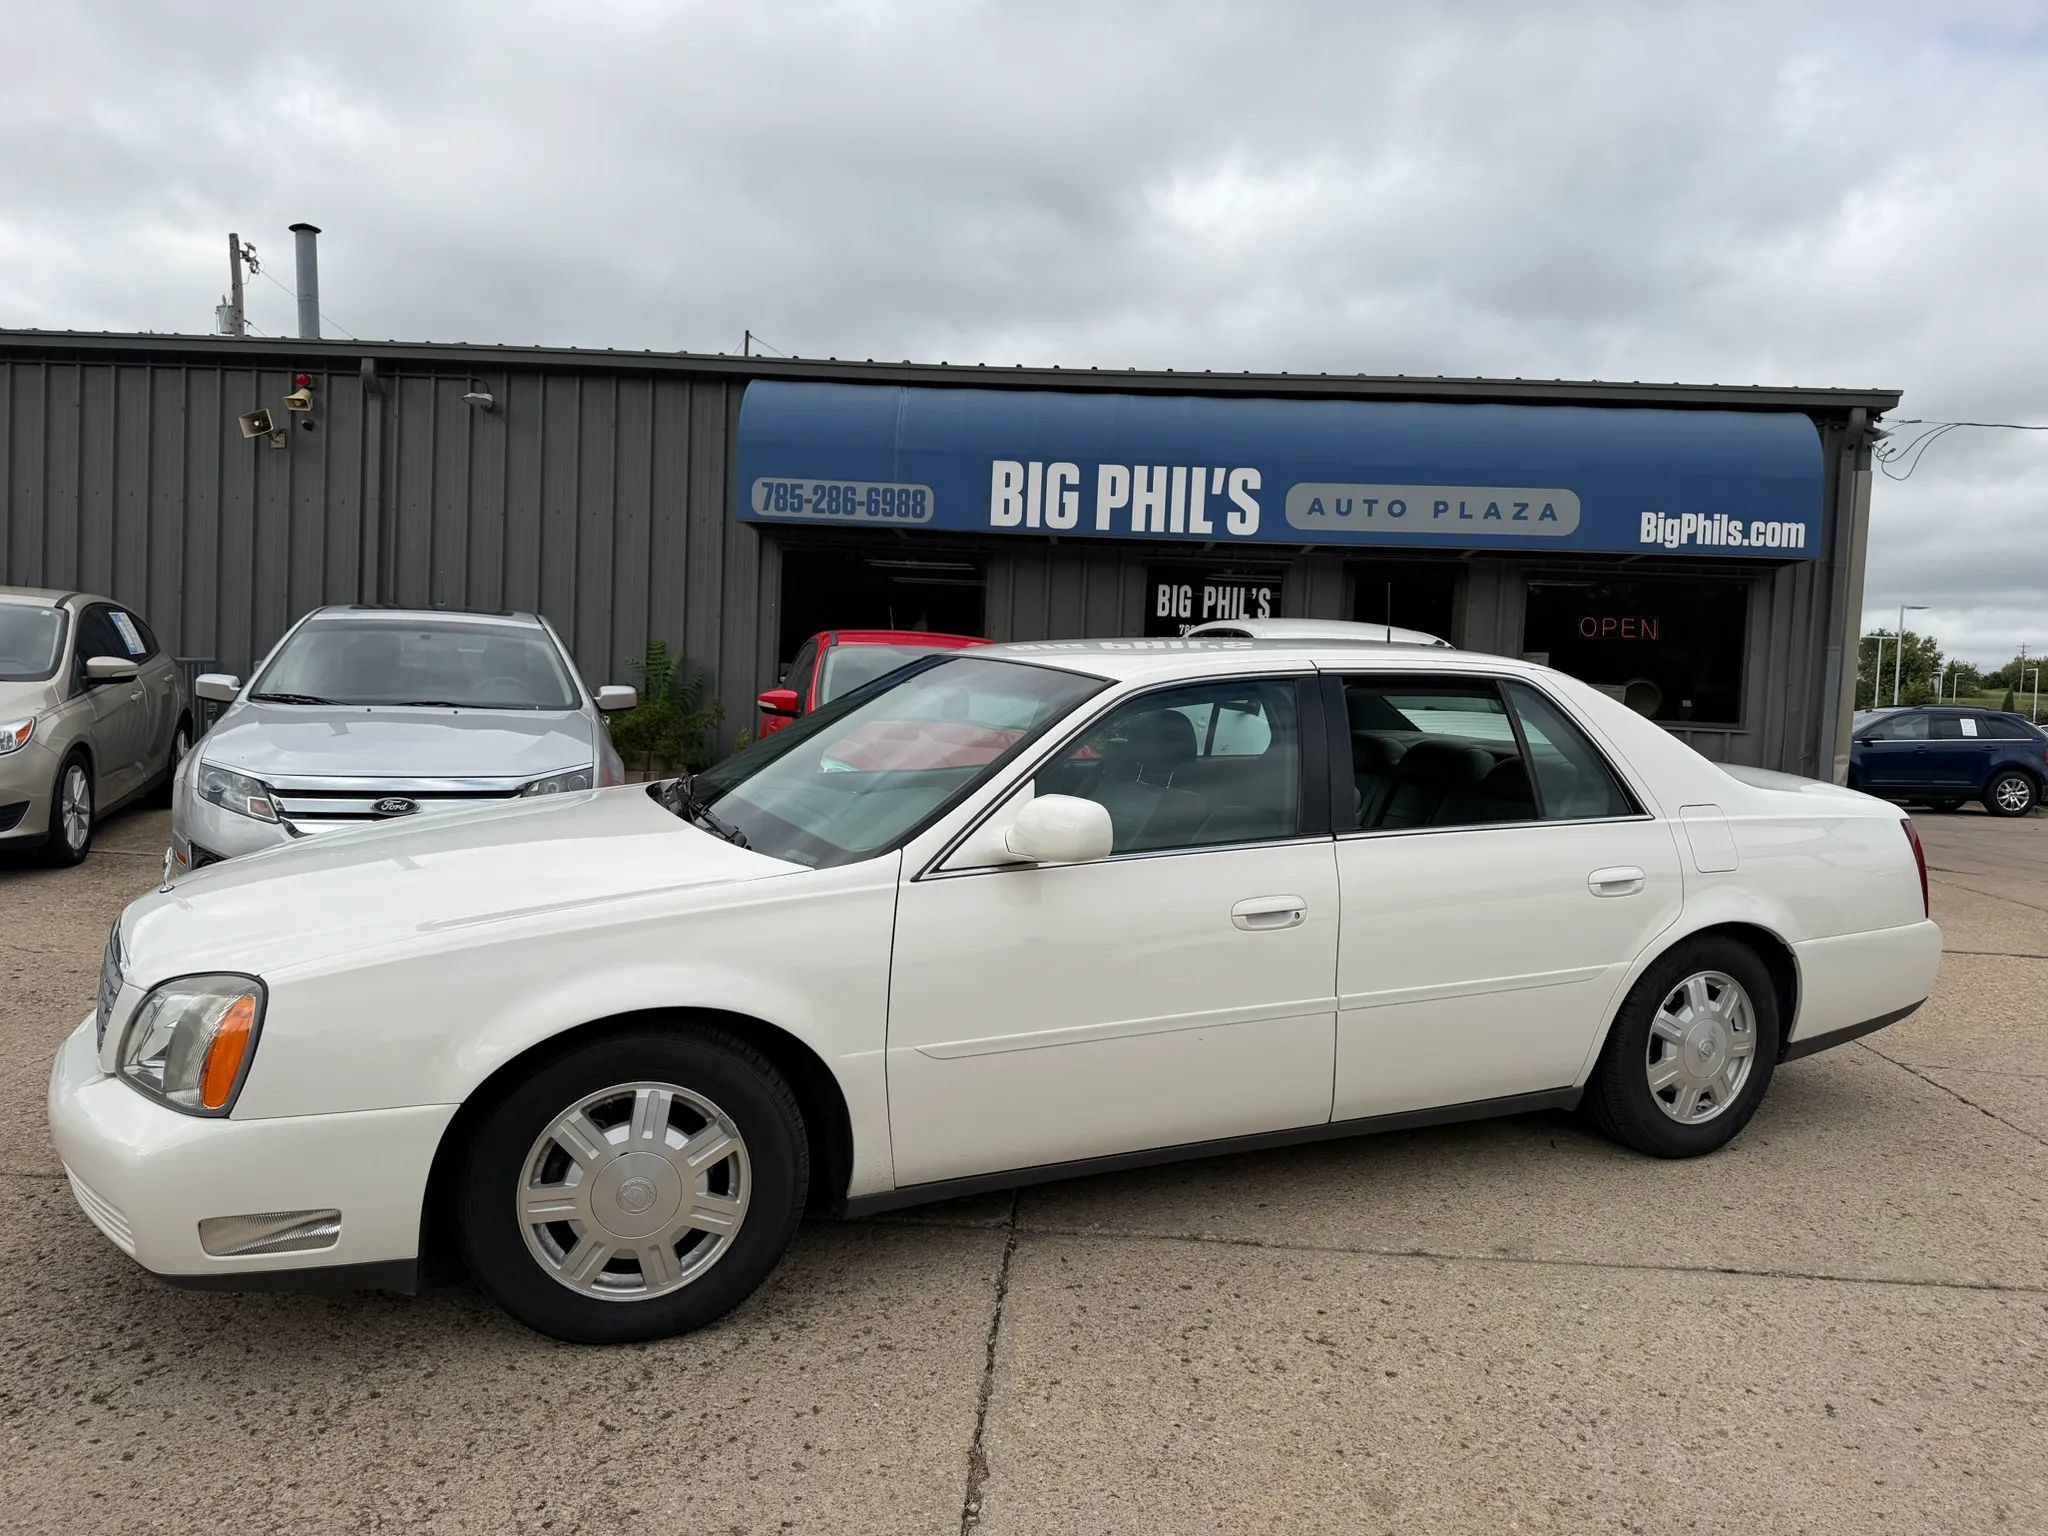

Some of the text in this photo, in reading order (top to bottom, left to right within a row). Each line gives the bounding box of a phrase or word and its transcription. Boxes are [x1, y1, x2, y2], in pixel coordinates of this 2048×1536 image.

[762, 481, 927, 519] 785-286-6988
[990, 460, 1262, 536] BIG PHIL'S
[1306, 497, 1560, 522] AUTO PLAZA
[1640, 511, 1806, 549] BigPhils.com
[1156, 584, 1271, 619] BIG PHIL'S
[1580, 616, 1658, 639] OPEN
[381, 800, 408, 811] Ford
